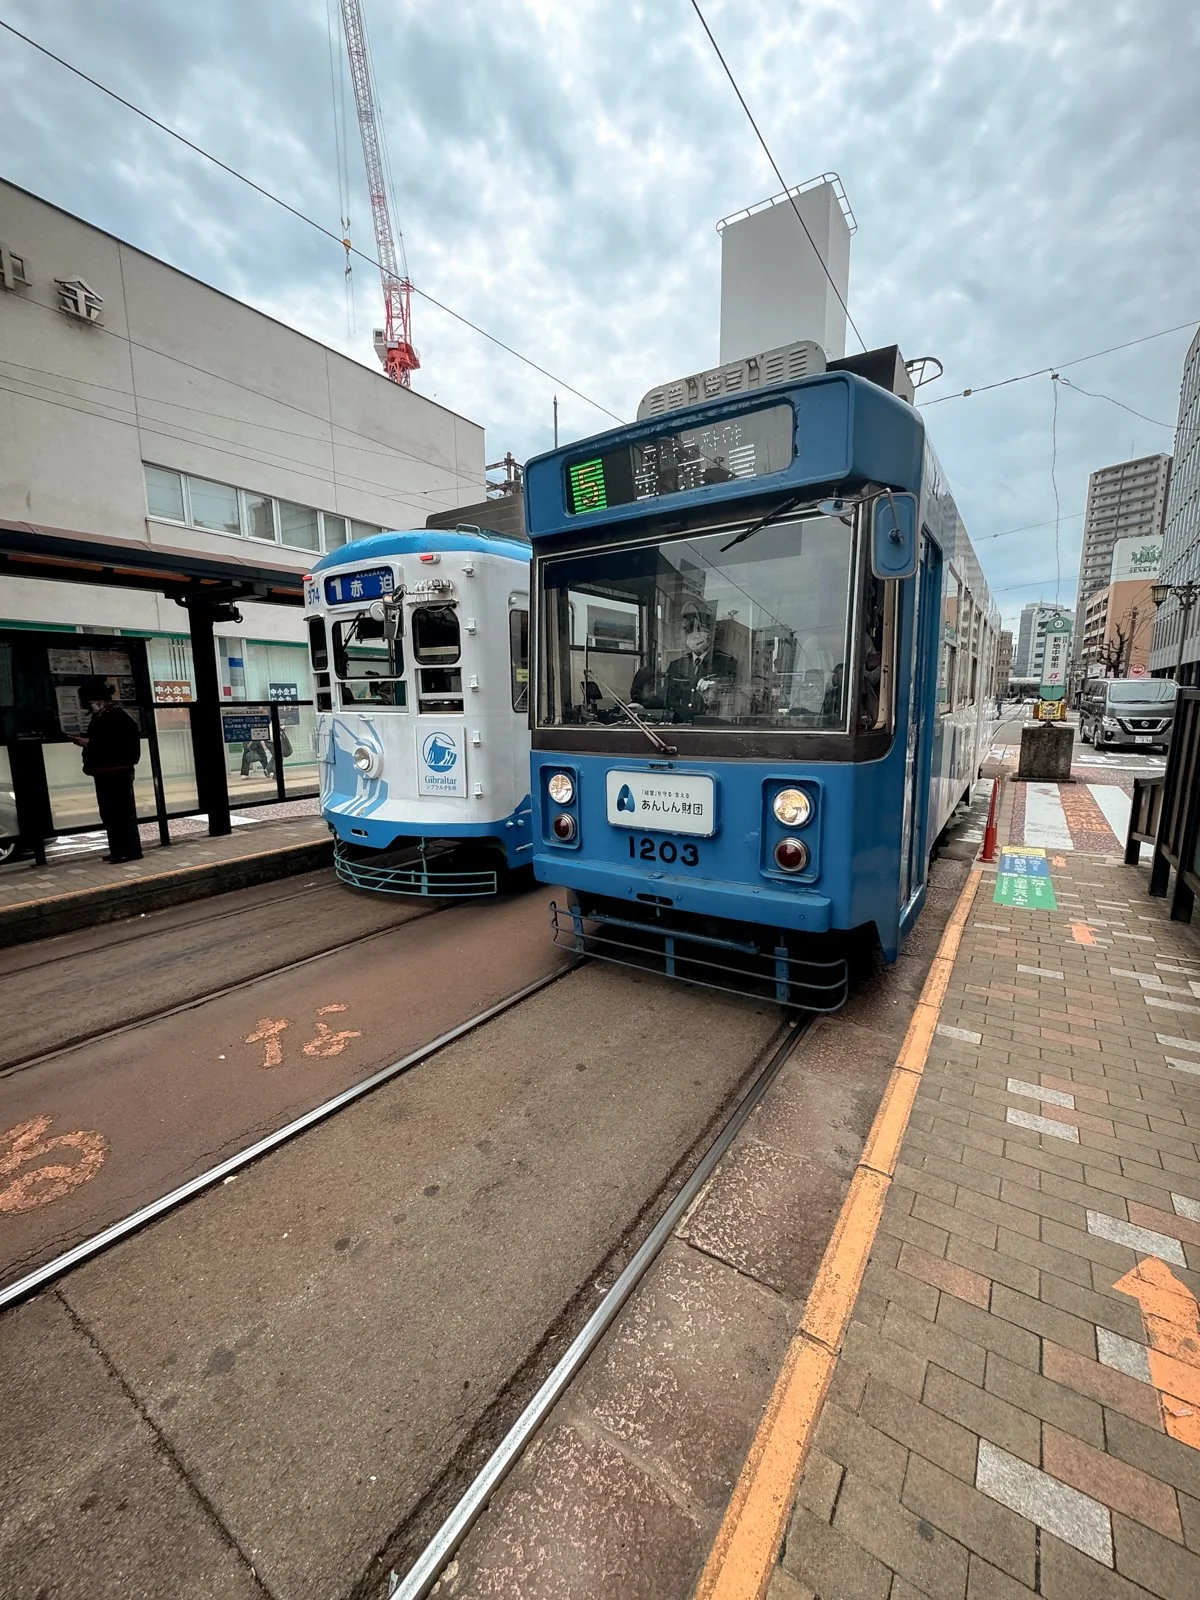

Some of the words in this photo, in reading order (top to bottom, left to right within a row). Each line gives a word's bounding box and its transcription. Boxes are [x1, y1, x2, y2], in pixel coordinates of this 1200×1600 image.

[578, 465, 600, 506] 5
[308, 587, 320, 605] 374
[331, 577, 343, 600] 1
[350, 573, 394, 598] 赤迫
[1050, 636, 1061, 669] 新地中華街
[155, 686, 190, 694] 中小企業
[424, 775, 458, 785] Gibraltar
[641, 799, 703, 816] あんしん財団
[629, 836, 700, 867] 1203
